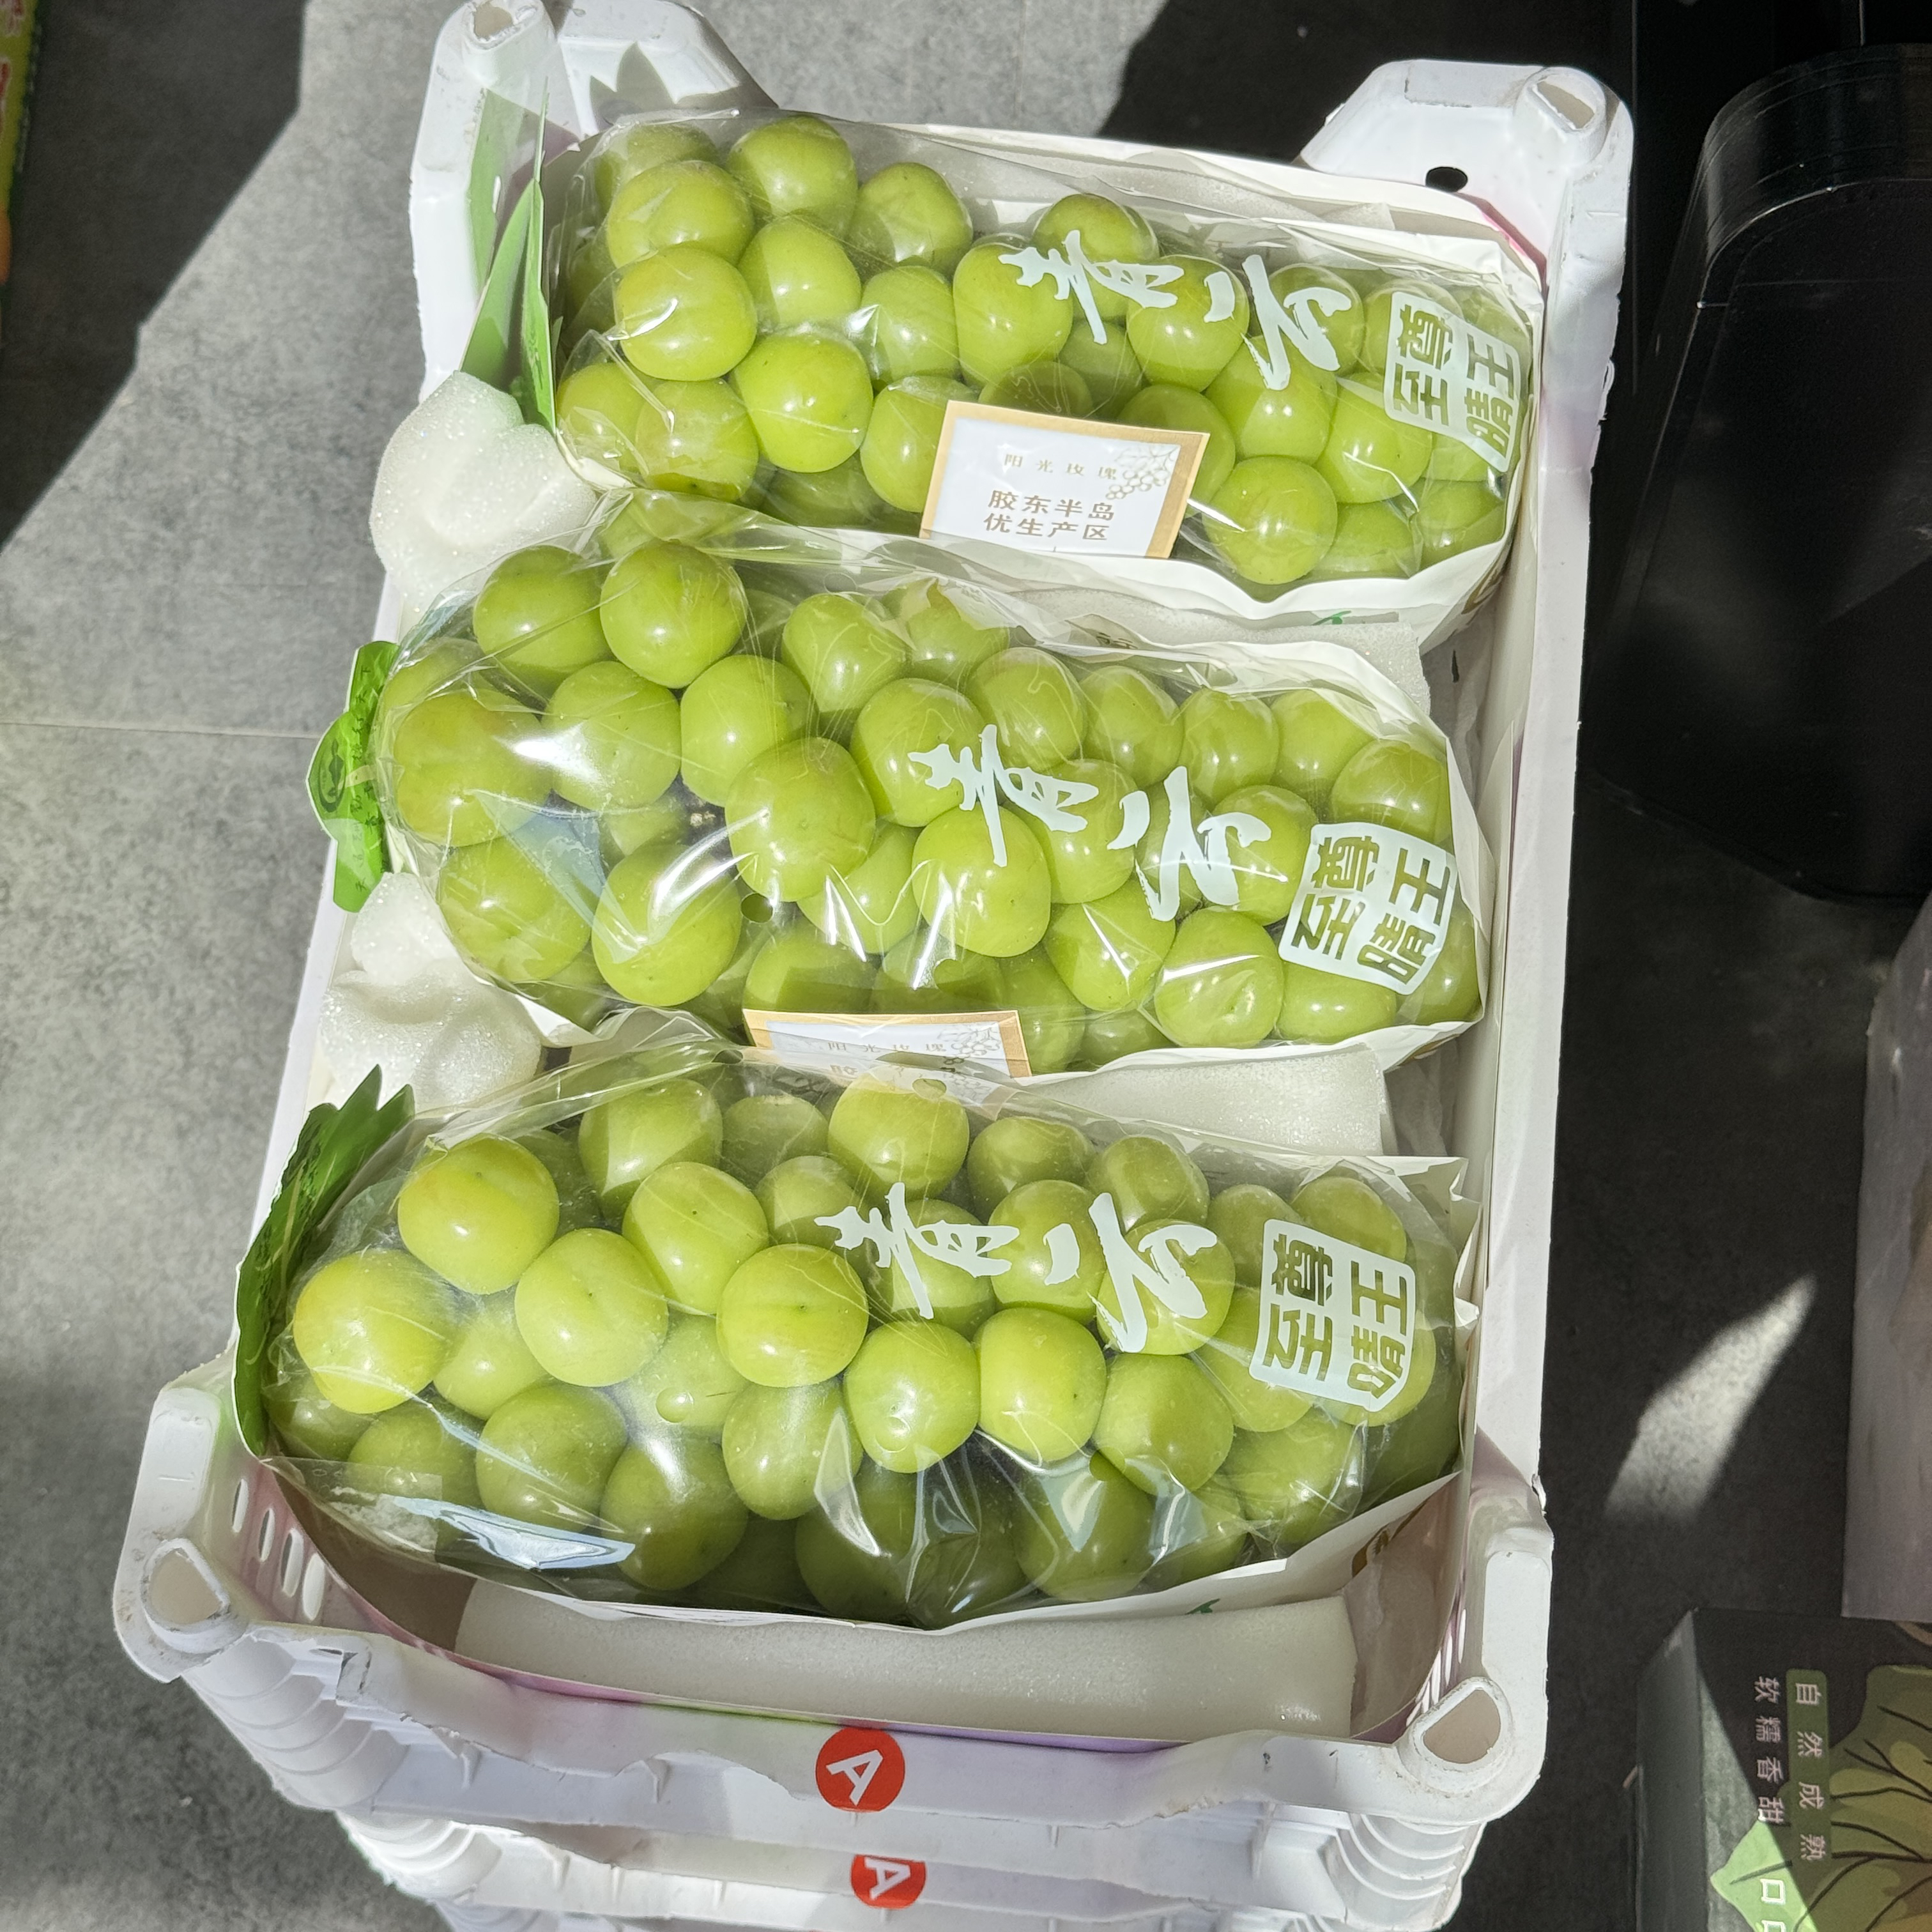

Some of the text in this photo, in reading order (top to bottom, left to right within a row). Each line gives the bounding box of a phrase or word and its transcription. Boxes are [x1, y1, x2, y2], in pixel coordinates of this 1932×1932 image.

[1392, 305, 1452, 425] 至尊
[988, 490, 1114, 521] 胶东半岛
[1004, 454, 1117, 480] 阳光玫瑰
[983, 512, 1110, 540] 优生产区
[1291, 836, 1379, 960] 至尊
[1263, 1234, 1333, 1381] 至尊
[826, 1749, 884, 1807] A
[1754, 1676, 1784, 1824] 软糯香甜
[1795, 1683, 1825, 1860] 自然成熟
[864, 1858, 911, 1900] A
